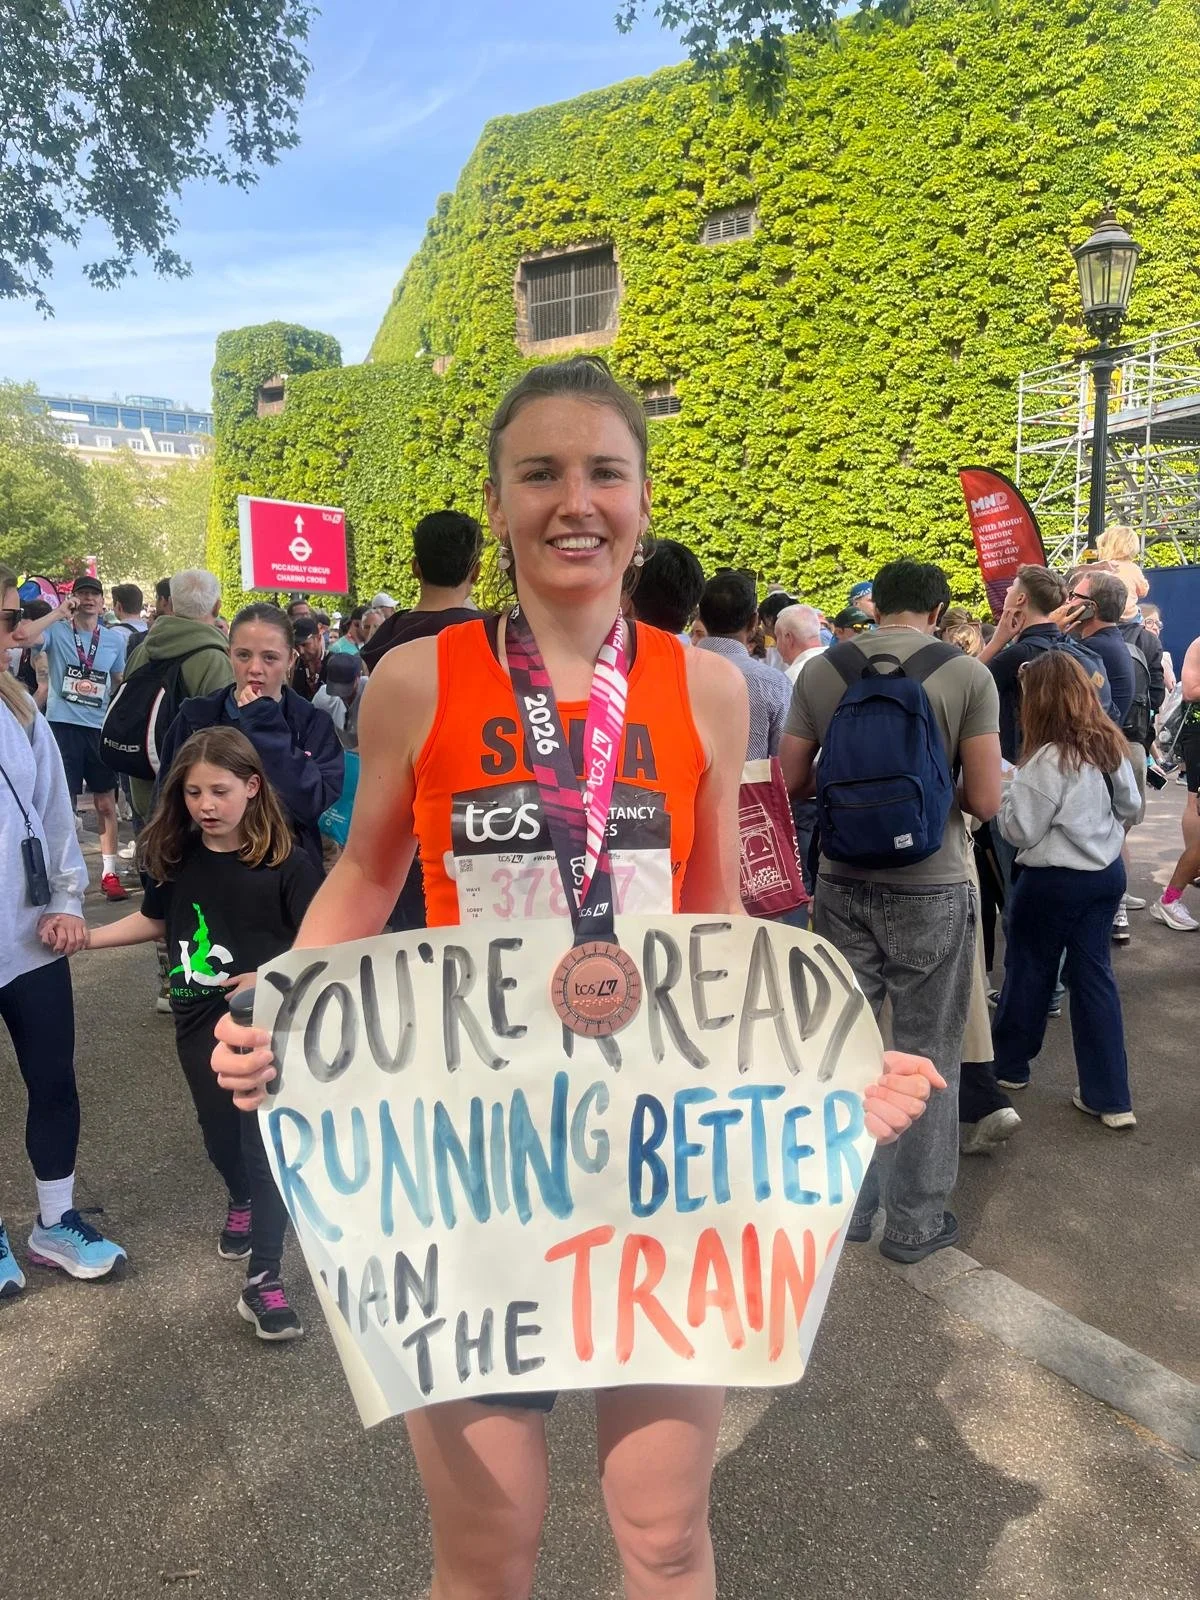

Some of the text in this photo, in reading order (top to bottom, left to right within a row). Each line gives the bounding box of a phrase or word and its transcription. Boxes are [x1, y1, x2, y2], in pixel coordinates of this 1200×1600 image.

[971, 491, 1007, 512] MND
[974, 504, 1010, 518] Association
[978, 516, 1023, 533] With Motor
[979, 529, 1013, 543] Neurone
[981, 538, 1016, 551] Disease,
[982, 545, 1019, 560] every day
[271, 563, 331, 575] PICCADILLY CIRCUS
[983, 556, 1018, 569] matters.
[276, 573, 327, 584] CHARING CROSS
[523, 693, 560, 756] 2026
[103, 737, 140, 752] HEAD
[586, 758, 607, 787] tcs
[465, 803, 540, 843] tcs
[491, 866, 637, 918] 3787
[575, 983, 596, 996] tcs
[264, 937, 528, 1096] YOU'RE
[268, 1070, 864, 1243] RUNNING BETTER
[402, 1300, 546, 1396] THE
